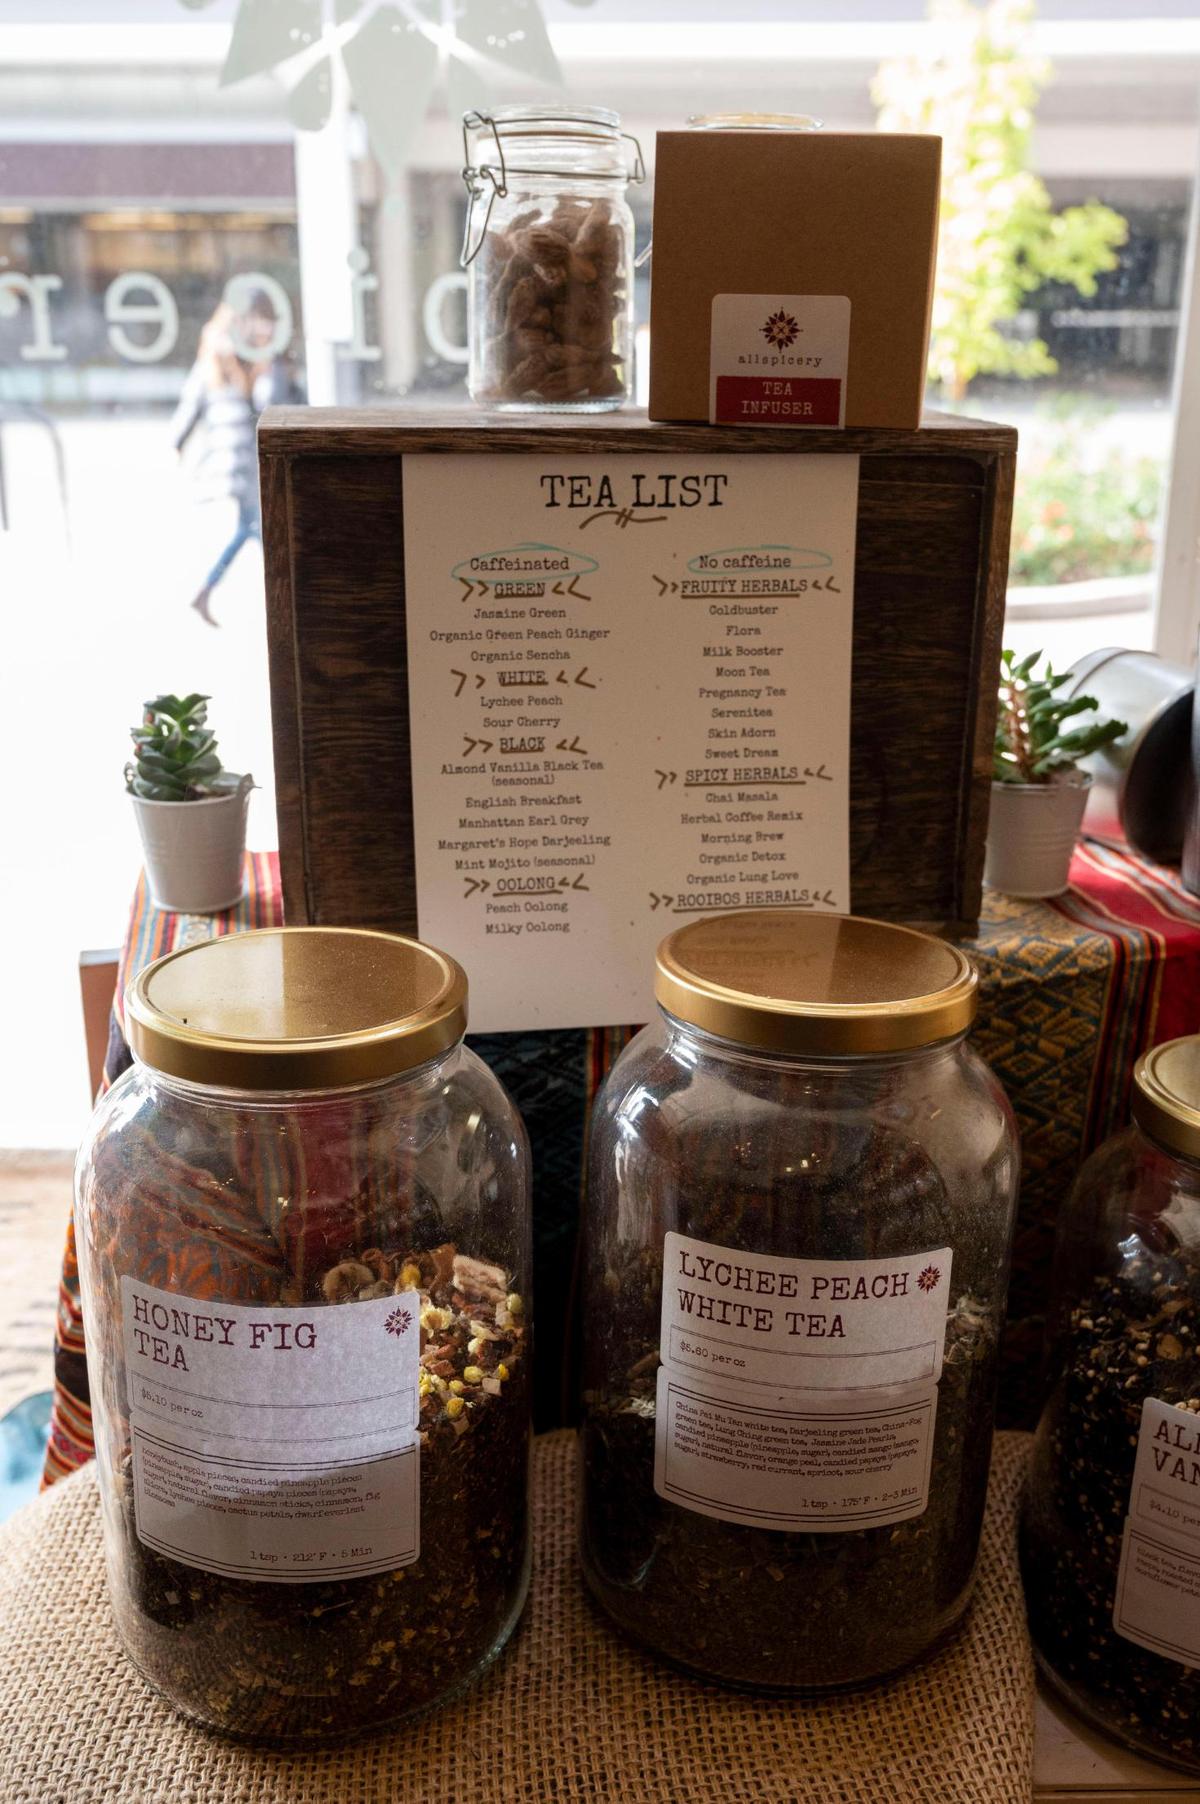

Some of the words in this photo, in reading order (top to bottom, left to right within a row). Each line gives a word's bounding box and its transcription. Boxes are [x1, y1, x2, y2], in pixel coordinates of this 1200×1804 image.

[738, 354, 821, 367] allspicery
[762, 381, 792, 395] TEA
[740, 400, 814, 415] INFUSER
[540, 475, 617, 508] TEA
[631, 475, 727, 507] LIST
[470, 557, 570, 570] Caffeinated
[699, 555, 718, 568] No
[722, 555, 792, 568] caffeine
[494, 583, 546, 596] GREEN
[681, 580, 737, 593] FRUITY
[741, 580, 808, 592] HERBALS
[473, 609, 526, 619] Jasmine
[529, 608, 566, 618] Green
[709, 605, 778, 615] Coldbuster
[430, 631, 482, 642] Organic
[486, 630, 522, 640] Green
[527, 630, 561, 640] Peach
[566, 629, 610, 640] Ginger
[726, 626, 761, 636] Flora
[471, 651, 523, 663] Organic
[526, 650, 570, 660] Sencha
[703, 646, 732, 656] Milk
[736, 646, 784, 656] Booster
[496, 671, 547, 684] WHITE
[716, 667, 746, 677] Moon
[749, 666, 770, 676] Tea
[699, 688, 762, 699] Pregnancy
[766, 687, 786, 696] Tea
[480, 696, 524, 708] Lychee
[527, 696, 563, 705] Peach
[712, 708, 773, 718] Serenitea
[483, 717, 513, 727] Sour
[517, 717, 561, 728] Cherry
[708, 728, 737, 738] Skin
[741, 728, 776, 737] Adorn
[500, 737, 546, 751] BLACK
[705, 749, 739, 759] Sweet
[743, 748, 778, 757] Dream
[441, 764, 485, 774] Almond
[489, 763, 539, 773] Vanilla
[543, 761, 578, 771] Black
[582, 760, 604, 770] Tea
[492, 774, 555, 786] (seasonal)
[686, 769, 728, 781] SPICY
[734, 767, 798, 780] HERBALS
[466, 798, 516, 809] English
[520, 795, 582, 807] Breakfast
[706, 793, 733, 803] Chai
[737, 792, 778, 802] Masala
[459, 818, 525, 828] Manhattan
[528, 816, 557, 826] Earl
[560, 815, 590, 826] Grey
[681, 814, 722, 824] Herbal
[725, 813, 764, 822] Coffee
[767, 812, 803, 821] Remix
[438, 839, 505, 850] Margaret's
[509, 838, 539, 848] Hope
[542, 835, 611, 847] Darjeeling
[702, 833, 752, 844] Morning
[756, 832, 784, 841] Brew
[456, 859, 485, 870] Mint
[489, 858, 530, 870] Mojito
[534, 855, 596, 867] (seasonal)
[699, 853, 749, 865] Organic
[752, 852, 786, 861] Detox
[497, 877, 555, 890] OOLONG
[687, 874, 736, 886] Organic
[739, 872, 768, 883] Lung
[771, 871, 799, 881] Love
[678, 893, 741, 906] ROOIBOS
[746, 890, 809, 904] HERBALS
[486, 903, 521, 913] Peach
[524, 902, 568, 913] Oolong
[486, 923, 522, 934] Milky
[526, 922, 570, 932] Oolong
[679, 1250, 798, 1297] LYCHEE
[811, 1273, 910, 1300] PEACH
[678, 1288, 772, 1332] WHITE
[785, 1311, 846, 1337] TEA
[132, 1294, 236, 1345] HONEY
[249, 1323, 317, 1349] FIG
[134, 1328, 189, 1371] TEA
[679, 1340, 708, 1358] $5.60
[712, 1353, 735, 1365] per
[734, 1358, 746, 1368] oz
[171, 1402, 190, 1415] per
[191, 1410, 203, 1418] oz
[1154, 1420, 1200, 1455] AL
[811, 1500, 828, 1509] tsp
[882, 1492, 899, 1501] 2-3
[901, 1487, 917, 1496] Min
[260, 1552, 278, 1563] tsp
[351, 1547, 373, 1557] Min
